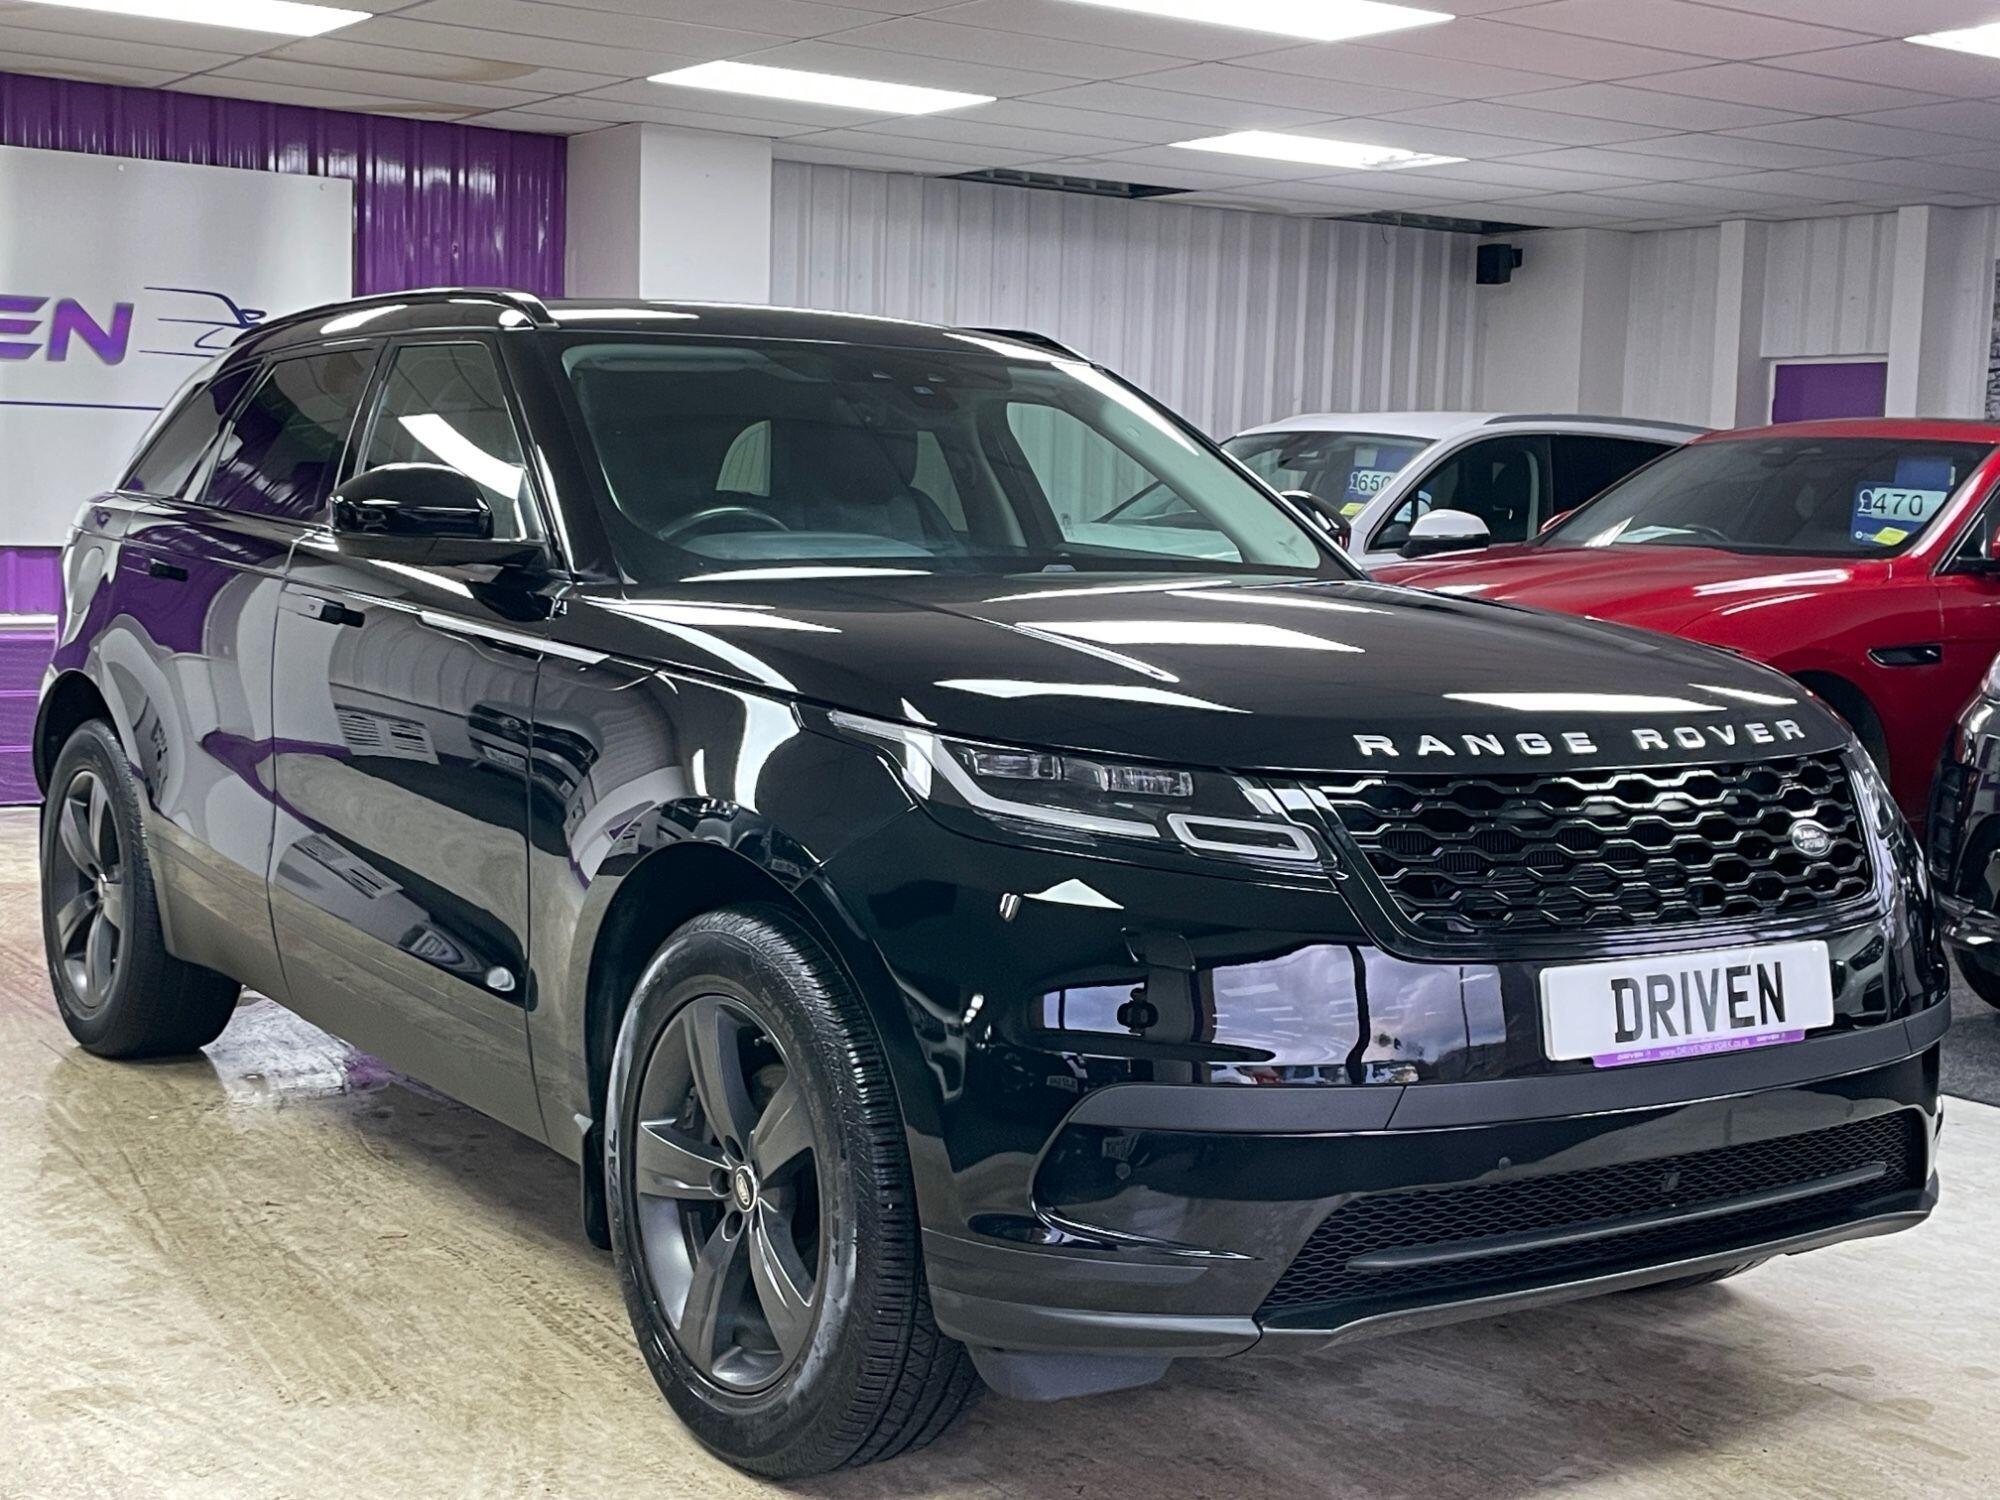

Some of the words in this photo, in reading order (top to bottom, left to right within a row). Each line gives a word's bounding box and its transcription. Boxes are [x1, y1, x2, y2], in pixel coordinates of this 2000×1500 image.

[1857, 489, 1923, 516] £470
[1353, 732, 1598, 757] RANGE
[1633, 719, 1806, 751] ROVER
[1611, 961, 1787, 1044] DRIVEN
